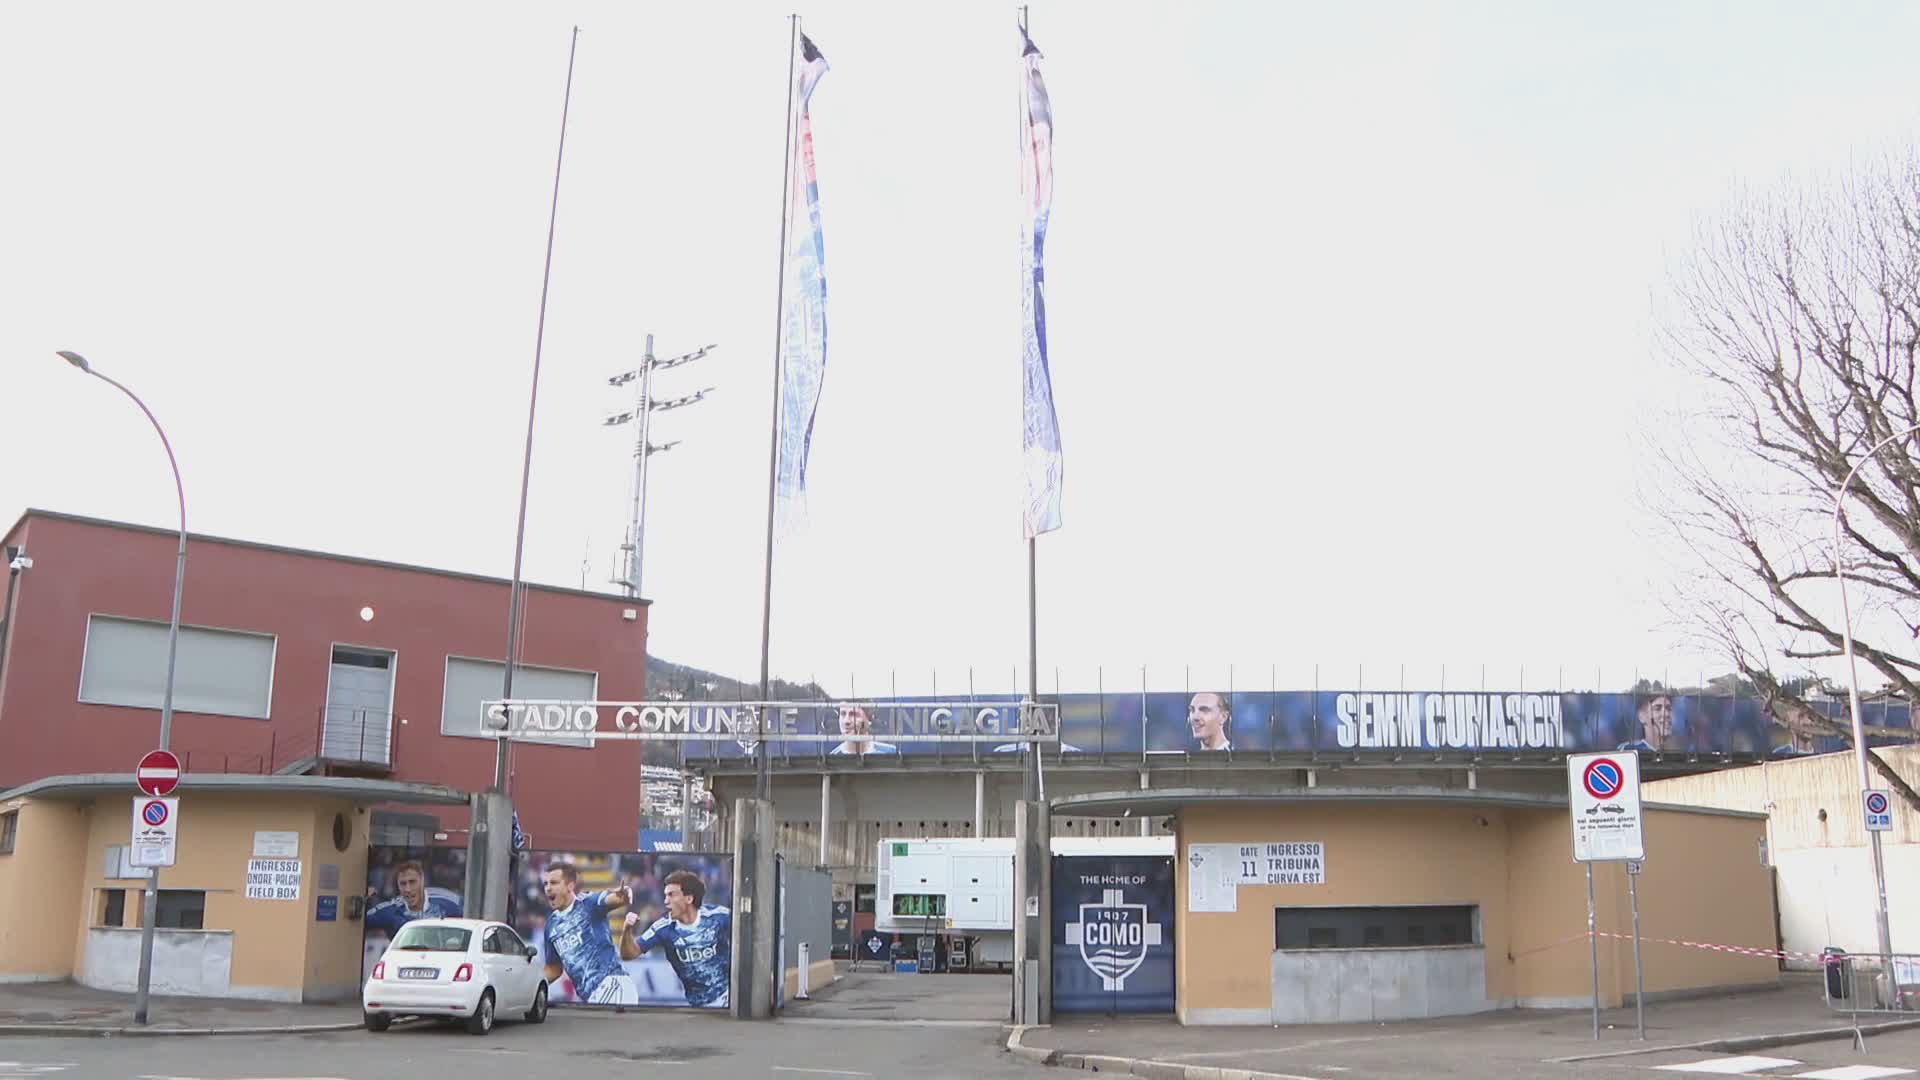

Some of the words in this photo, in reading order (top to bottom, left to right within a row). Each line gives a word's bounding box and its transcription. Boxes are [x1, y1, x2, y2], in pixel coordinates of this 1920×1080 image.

[487, 705, 599, 731] STADIO
[1336, 693, 1422, 748] SEMM
[1240, 847, 1259, 857] GATE
[1267, 843, 1320, 856] INGRESSO
[250, 860, 299, 872] INGRESSO
[1242, 861, 1258, 877] 11
[1267, 858, 1320, 871] TRIBUNA
[1080, 875, 1100, 885] THE
[1132, 875, 1146, 885] OF
[1267, 873, 1300, 884] CURVA
[1302, 873, 1320, 883] EST
[248, 887, 274, 898] FIELD
[276, 888, 297, 899] BOX
[1097, 911, 1129, 921] 1907
[1086, 922, 1141, 946] COMO
[675, 945, 717, 963] Uber
